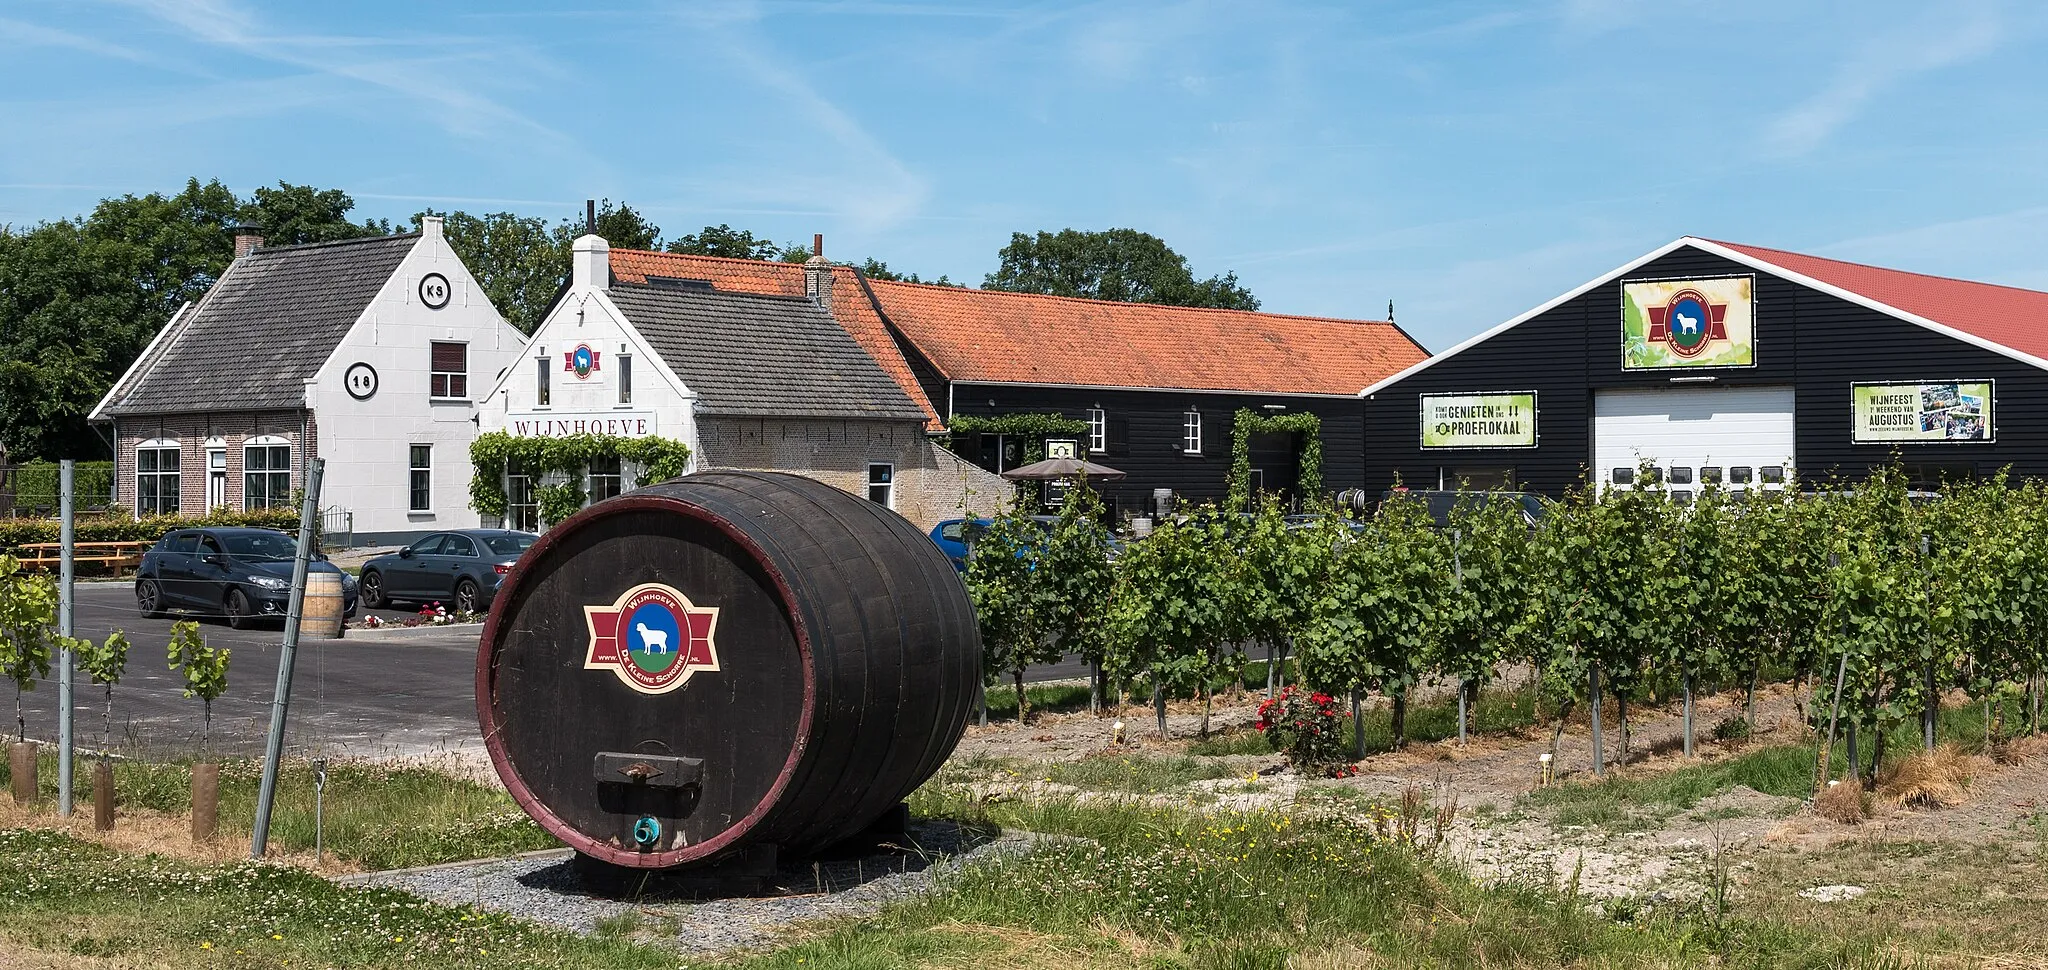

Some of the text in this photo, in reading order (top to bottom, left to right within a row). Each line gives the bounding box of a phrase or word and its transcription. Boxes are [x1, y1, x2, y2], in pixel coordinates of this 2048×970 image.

[427, 285, 443, 298] KS
[353, 375, 370, 387] 18
[1870, 394, 1914, 405] WIJNFEEST
[1449, 406, 1494, 418] GENIETEN
[1869, 414, 1914, 426] AUGUSTUS
[515, 419, 647, 437] WIJNHOEVE
[1452, 421, 1520, 435] PROEFLOKAAL
